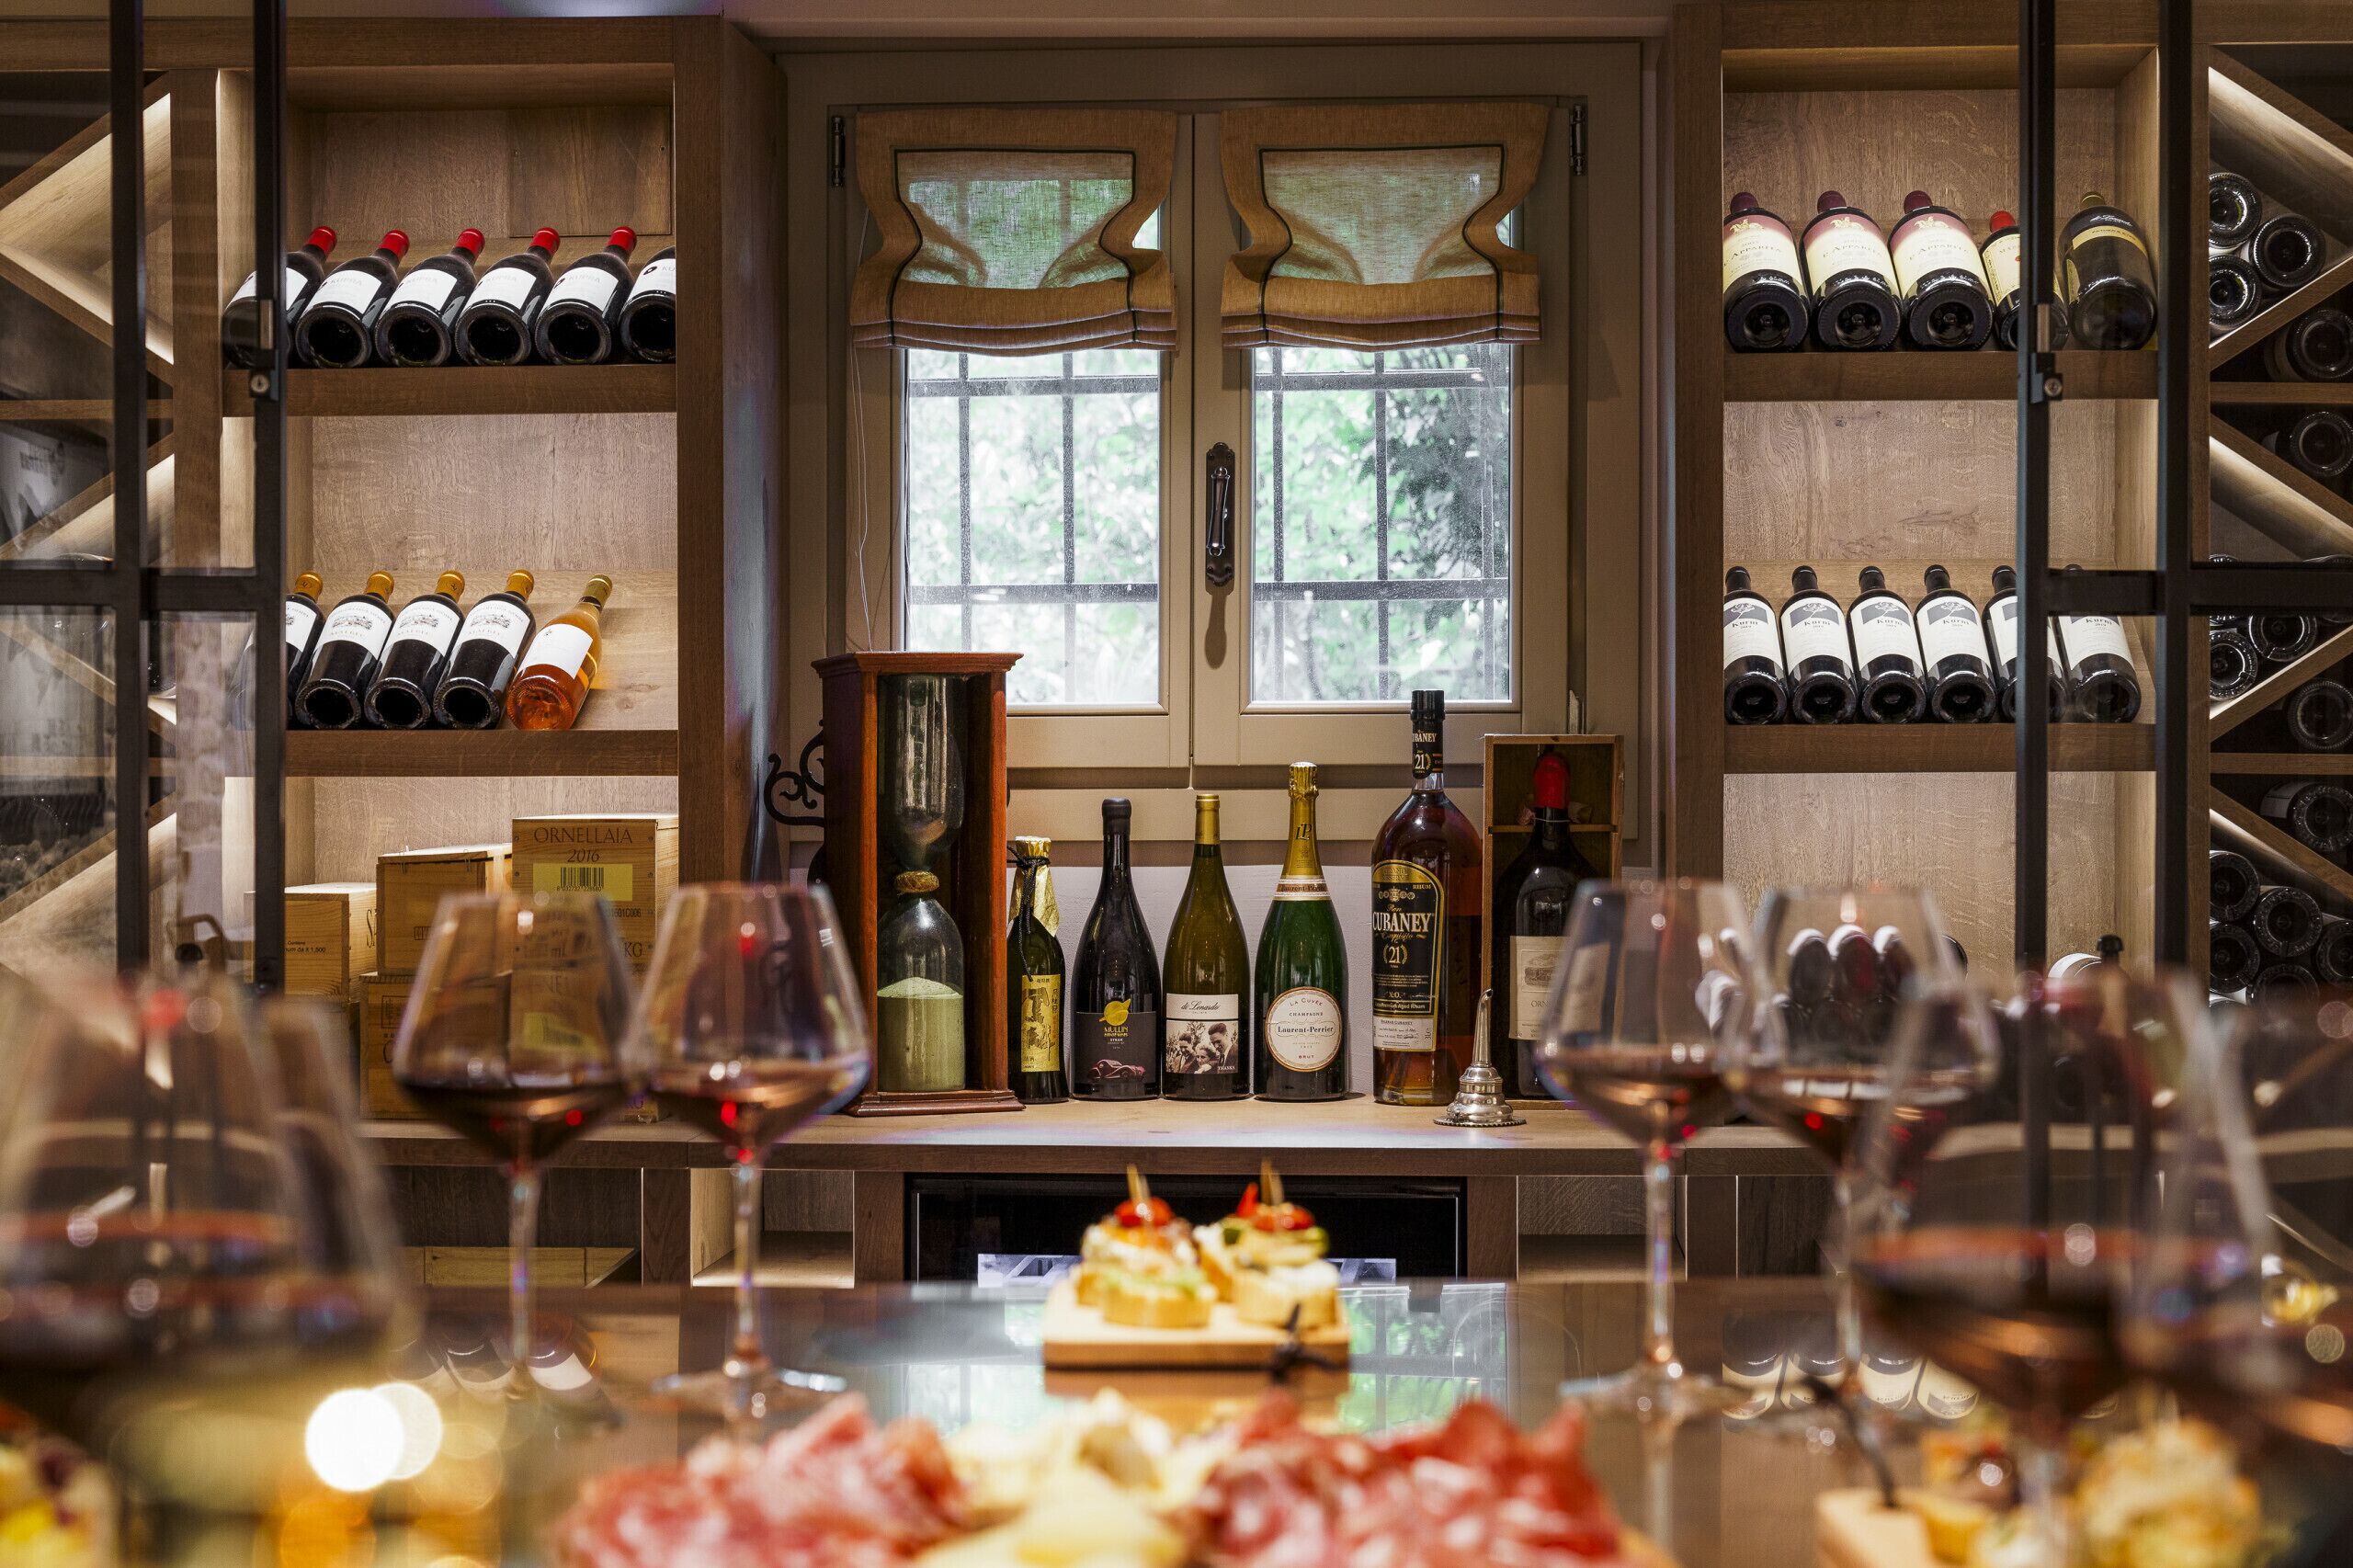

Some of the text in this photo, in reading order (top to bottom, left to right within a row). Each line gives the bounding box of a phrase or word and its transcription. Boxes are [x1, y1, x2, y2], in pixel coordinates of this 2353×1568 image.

[1415, 754, 1425, 769] 21
[534, 827, 632, 844] ORNELLAIA
[567, 848, 600, 863] 2016
[1372, 912, 1431, 933] CUBANEY
[624, 942, 643, 958] KG
[1389, 946, 1401, 964] 21
